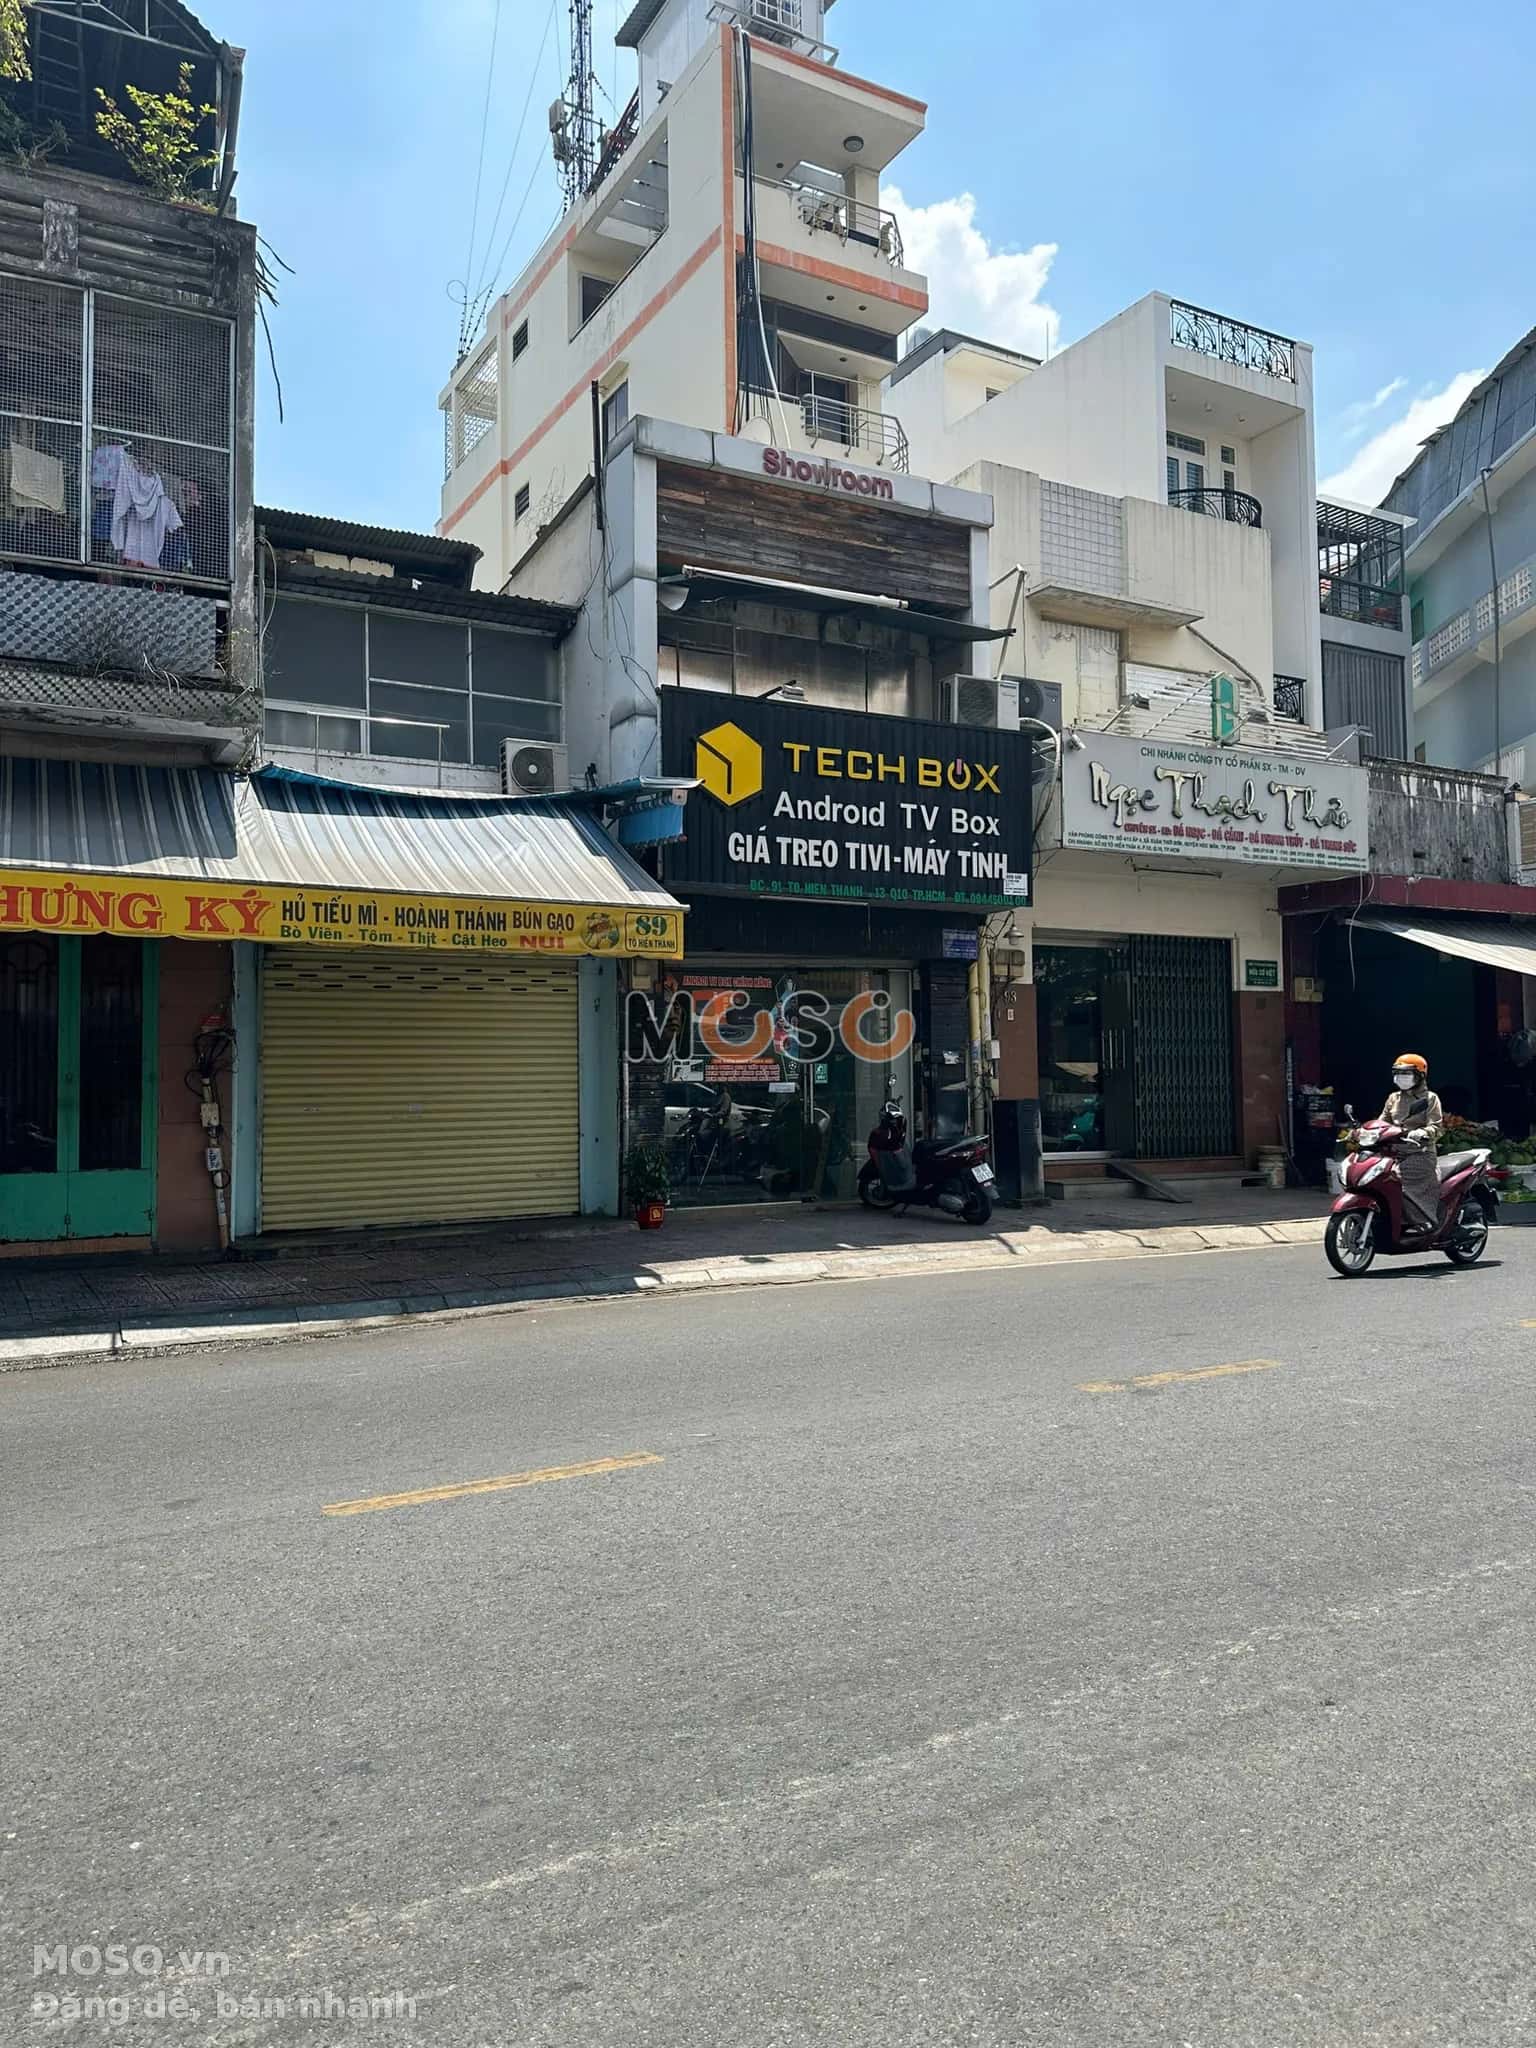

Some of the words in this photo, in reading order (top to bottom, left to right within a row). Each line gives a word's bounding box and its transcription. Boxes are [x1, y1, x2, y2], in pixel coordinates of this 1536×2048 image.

[762, 447, 893, 499] Showroom
[1140, 747, 1156, 757] CHI
[1214, 756, 1224, 767] TY
[1262, 762, 1272, 772] SX
[1278, 764, 1289, 774] TM
[773, 791, 885, 827] Android
[900, 803, 939, 831] TV
[951, 808, 1001, 837] Box
[728, 825, 771, 864] GIÁ
[776, 836, 839, 868] TREO
[957, 842, 1008, 880] TÍNH
[185, 889, 275, 934] KÝ
[282, 893, 306, 923] HỦ
[312, 895, 351, 925] TIẾU
[358, 900, 378, 926] MÌ
[395, 902, 449, 929] HOÀNH
[455, 905, 507, 932] THÁNH
[512, 906, 542, 930] BÚN
[547, 911, 575, 935] GẠO
[636, 915, 667, 936] 89
[280, 925, 302, 938] Bò
[308, 926, 342, 940] Viên
[359, 928, 393, 943] Tôm
[408, 931, 437, 948] Thịt
[452, 932, 477, 949] Cật
[481, 934, 508, 947] Heo
